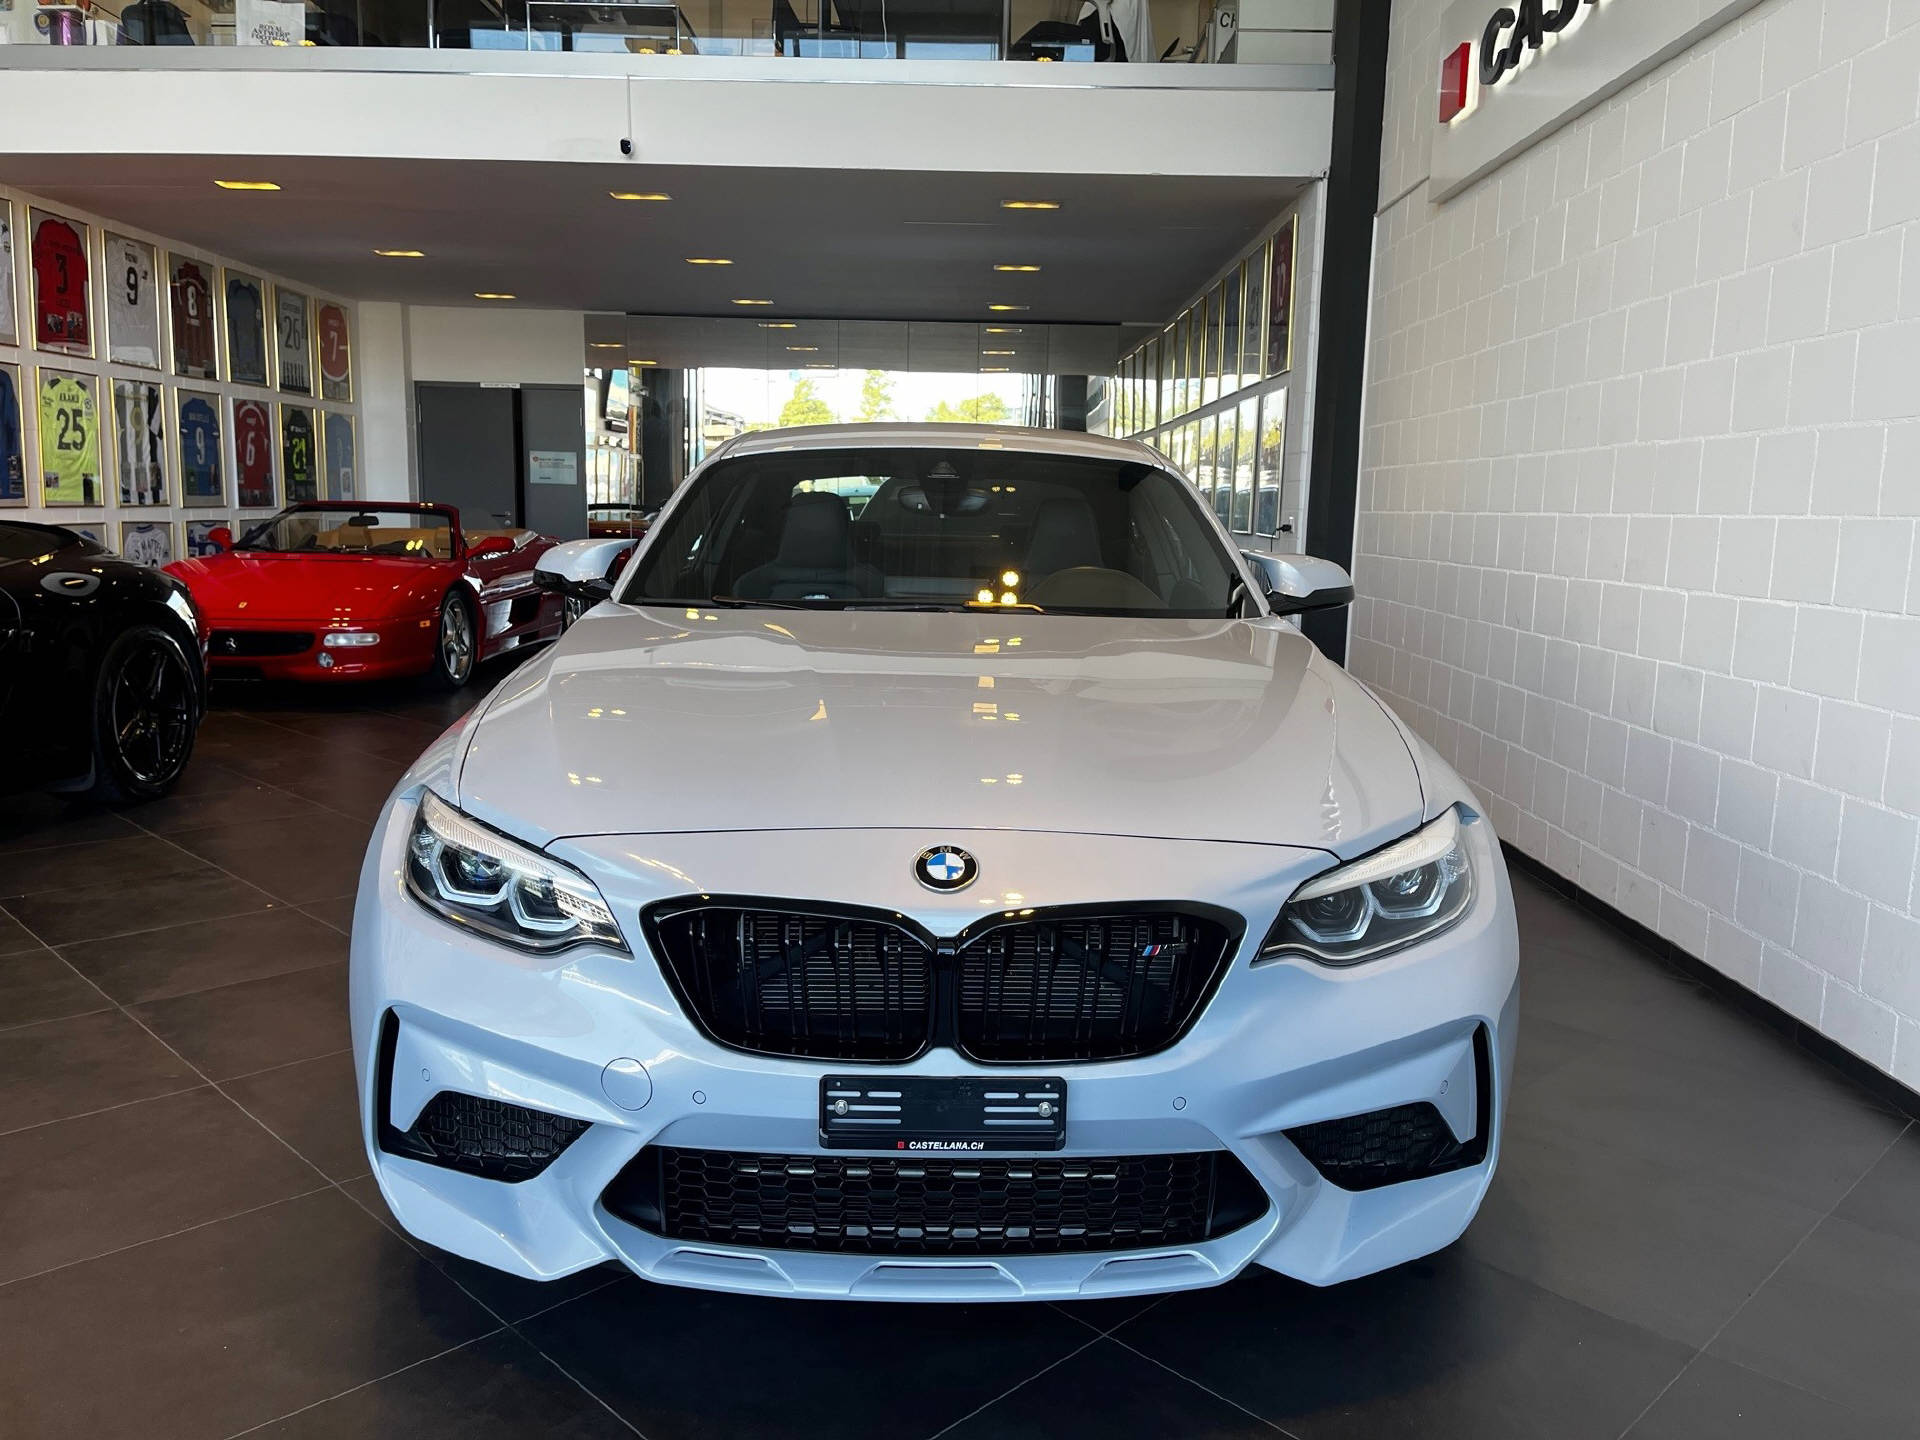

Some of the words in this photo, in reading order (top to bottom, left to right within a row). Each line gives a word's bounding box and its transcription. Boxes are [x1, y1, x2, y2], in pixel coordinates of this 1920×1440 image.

[252, 27, 291, 39] ANTWERP
[259, 23, 282, 33] ROYAL
[126, 266, 138, 306] 9
[186, 284, 198, 317] 8
[283, 315, 301, 351] 26
[329, 330, 338, 362] 7
[56, 407, 87, 451] 25
[195, 426, 206, 465] 9
[245, 430, 256, 467] 6
[908, 1141, 985, 1151] CASTELLANA.CH
